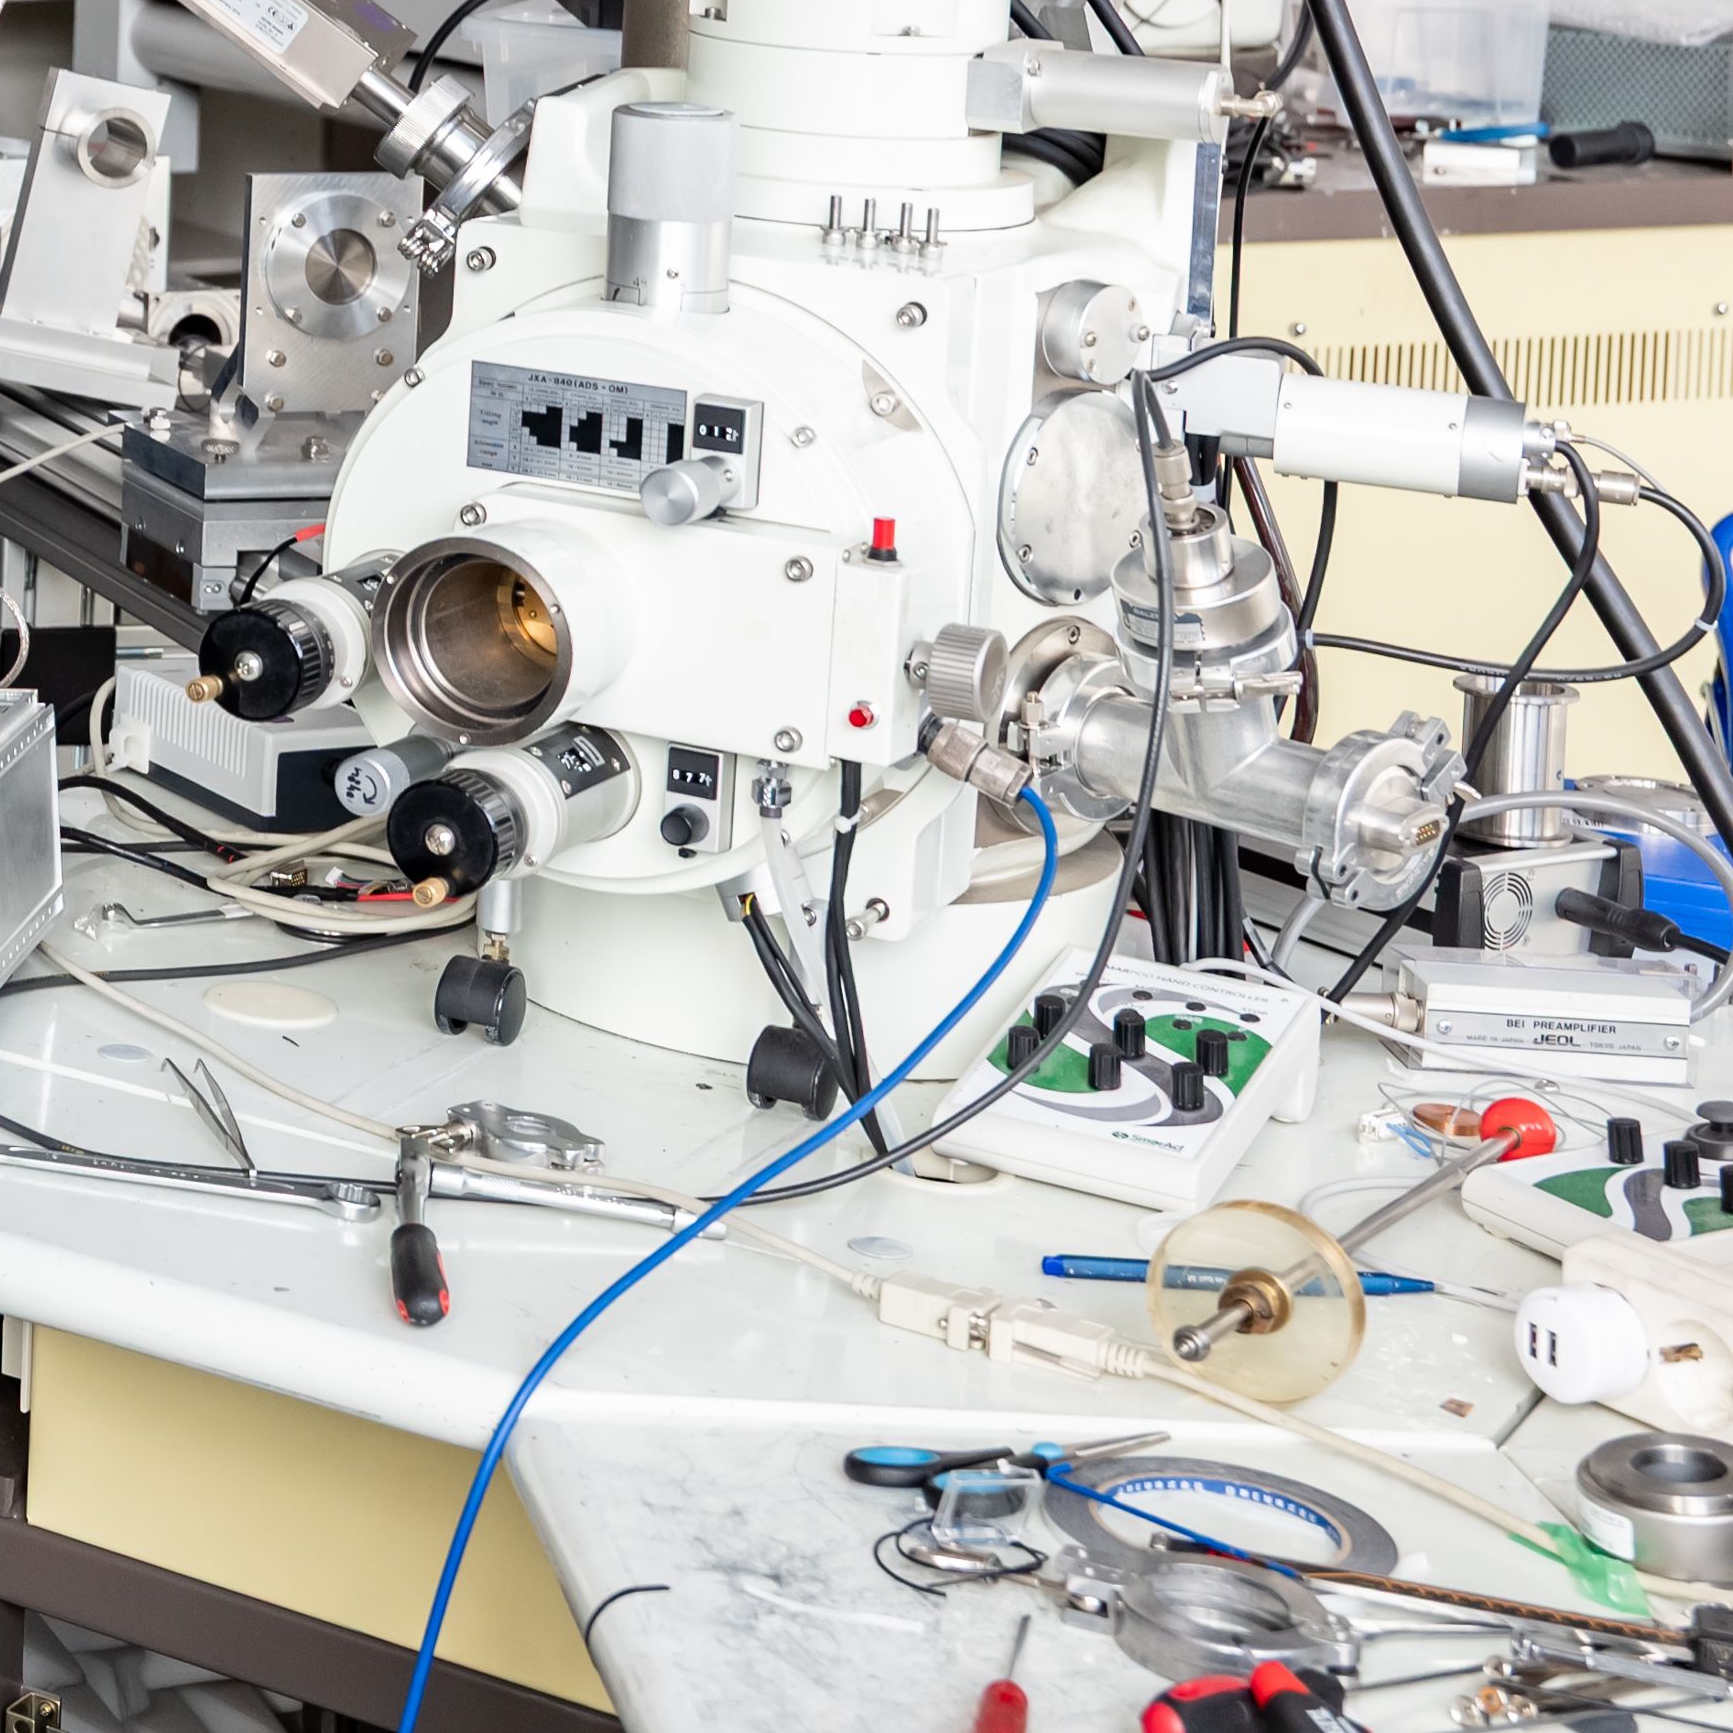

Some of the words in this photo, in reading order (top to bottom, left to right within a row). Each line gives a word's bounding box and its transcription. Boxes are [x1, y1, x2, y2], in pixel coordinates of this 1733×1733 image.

[1104, 963, 1154, 982] MARPOD
[1156, 974, 1190, 988] HAND
[1191, 980, 1270, 1004] CONTROLLER
[1506, 1018, 1525, 1029] BEI
[1533, 1019, 1617, 1035] PREAMPLIFIER
[1532, 1034, 1581, 1048] JEOL
